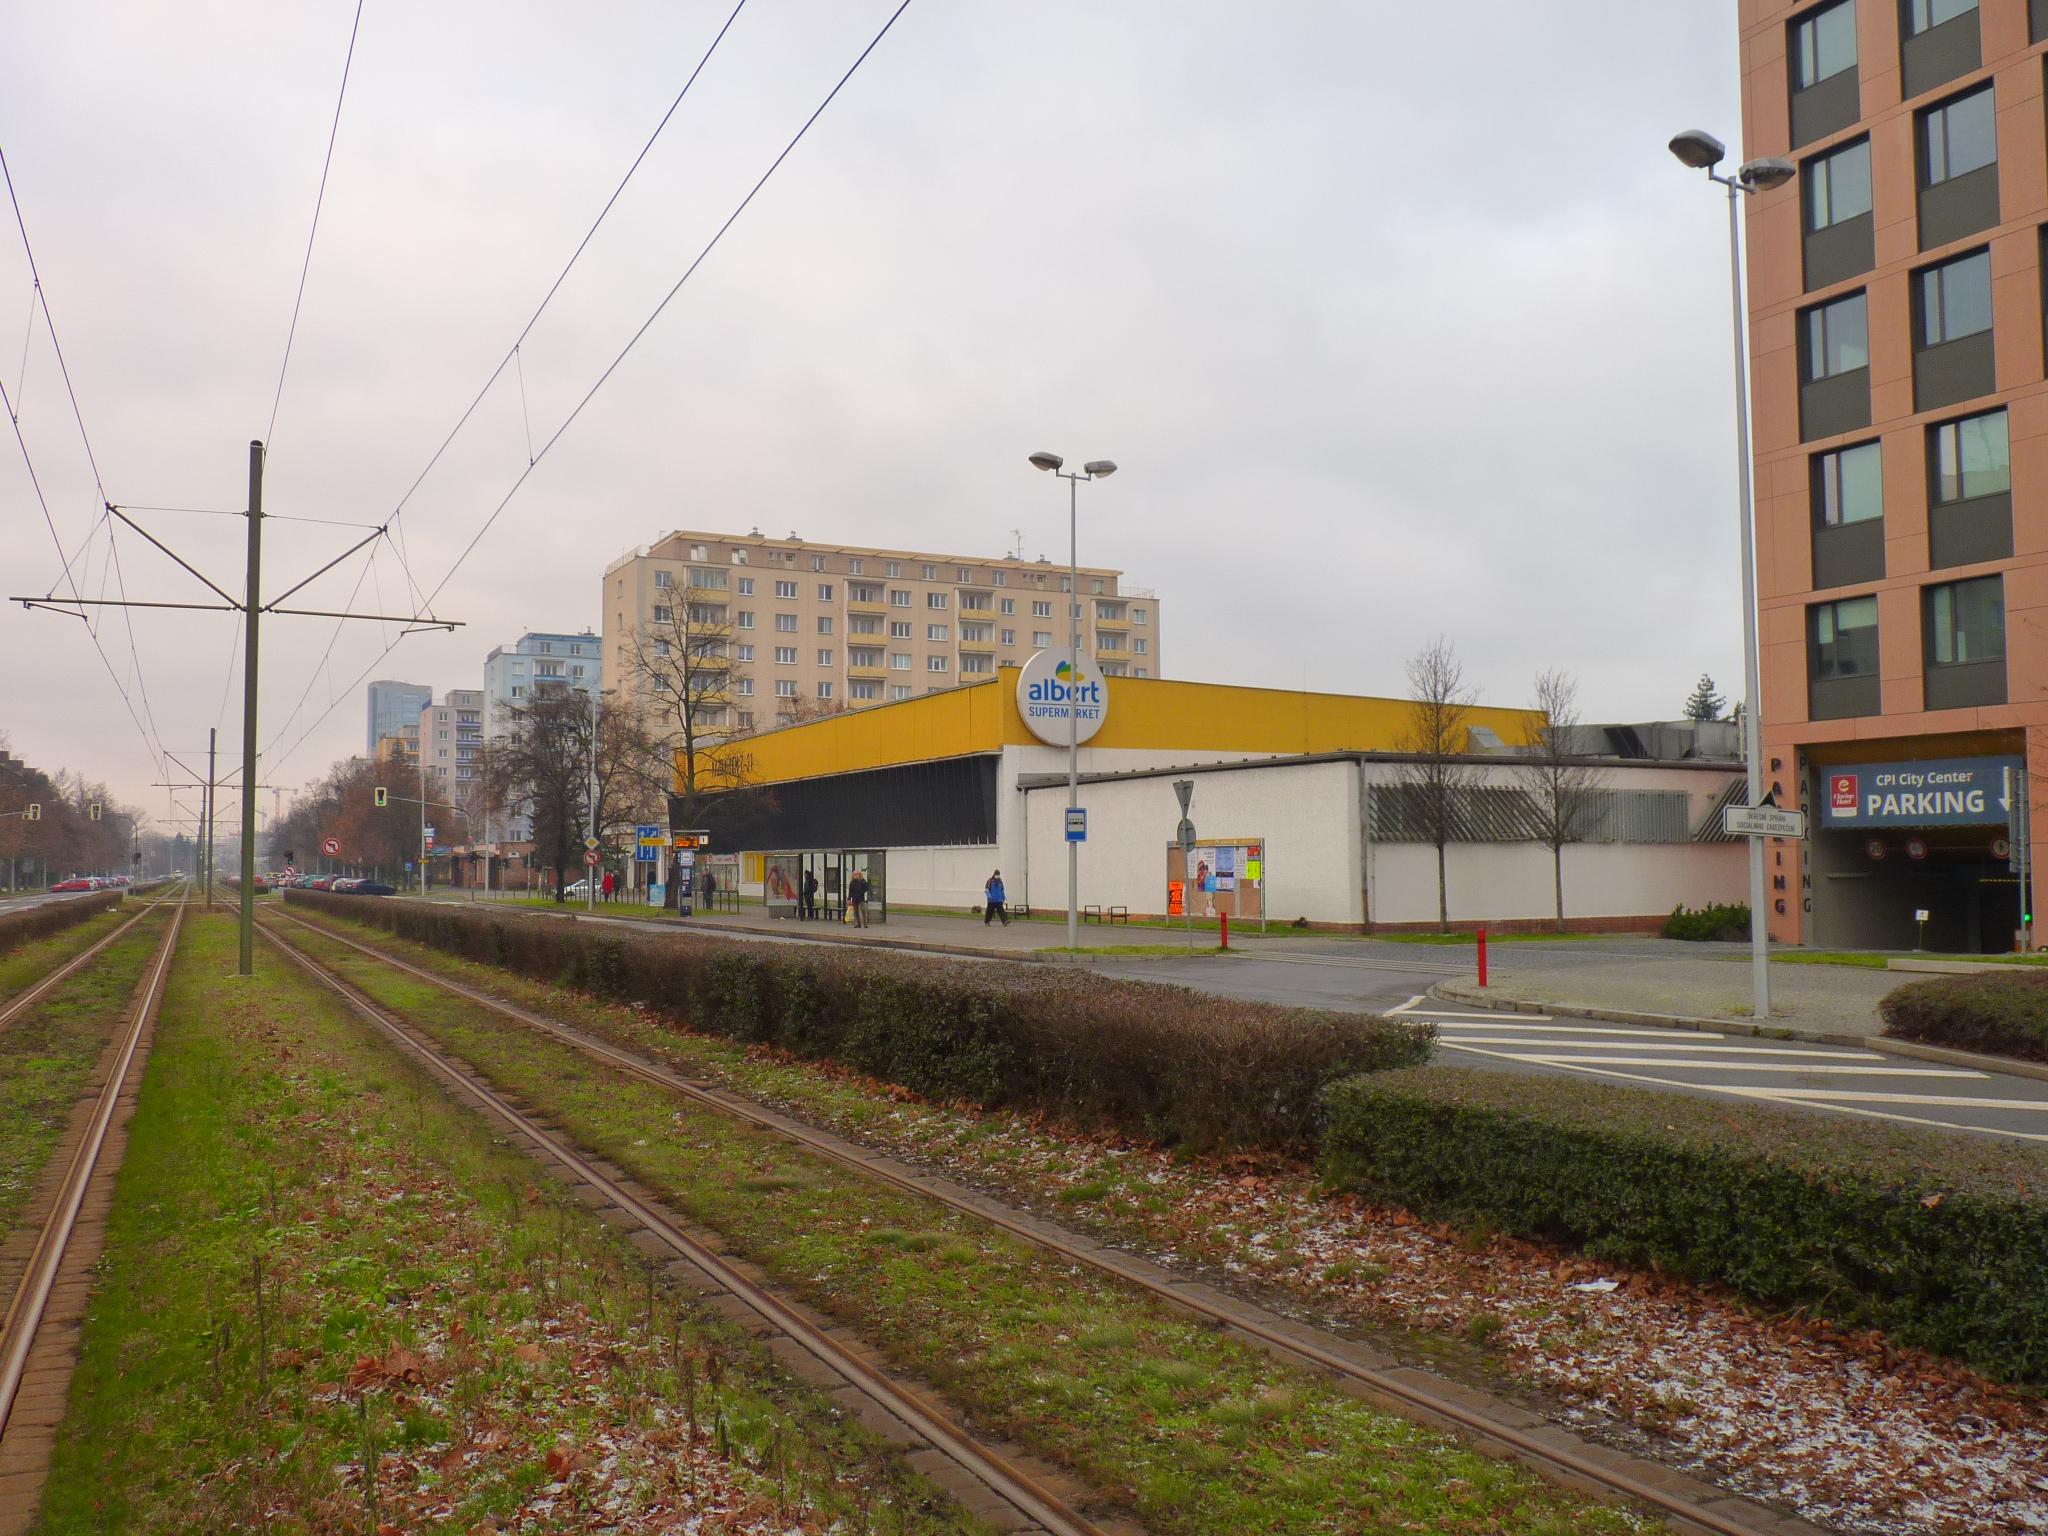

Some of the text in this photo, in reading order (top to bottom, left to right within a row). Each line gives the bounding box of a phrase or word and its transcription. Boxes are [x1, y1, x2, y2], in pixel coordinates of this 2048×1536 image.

[1028, 678, 1100, 703] albert
[1028, 705, 1100, 719] SUPERMRKET
[1876, 771, 1973, 787] CPI City Center
[1867, 789, 1985, 816] PARKING
[1770, 757, 1786, 914] PAING
